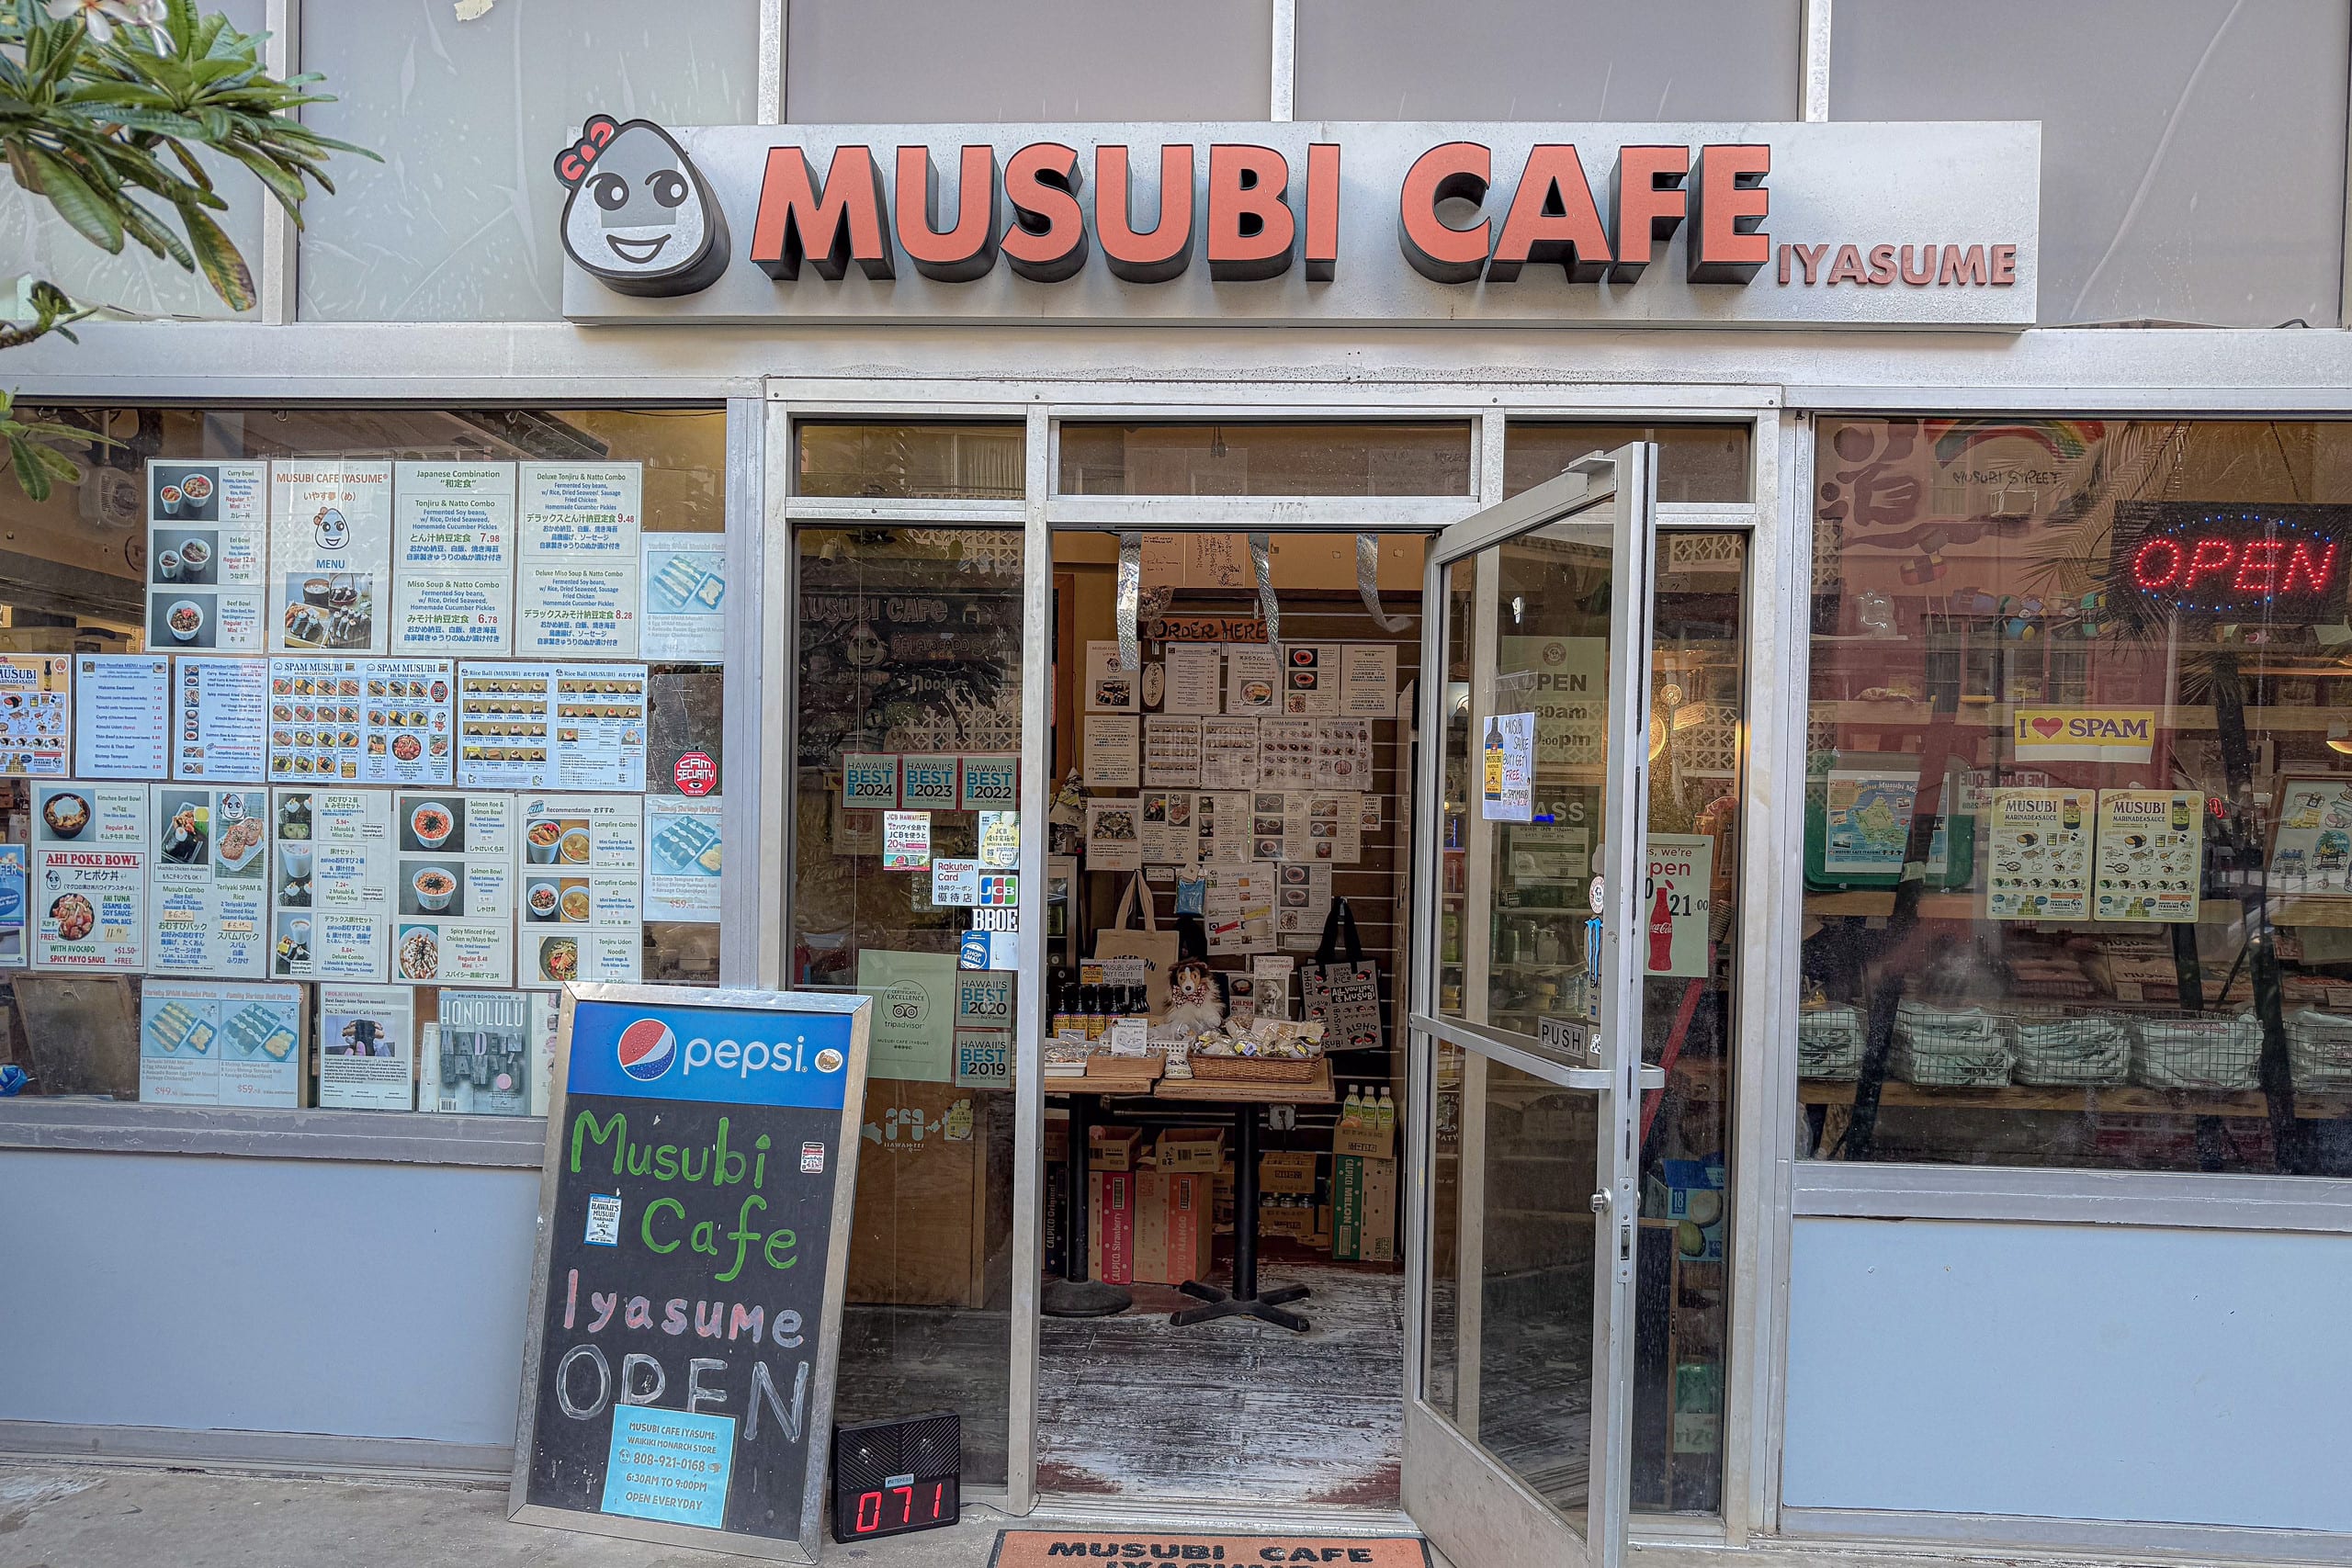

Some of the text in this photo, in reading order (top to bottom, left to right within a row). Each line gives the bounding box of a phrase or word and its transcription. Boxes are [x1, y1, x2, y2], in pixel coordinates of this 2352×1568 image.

[750, 141, 2017, 287] MUSUBI CAFE IYASUME
[277, 473, 339, 483] MUSUBI CAFE
[416, 470, 451, 479] Japanese
[1953, 469, 2063, 486] MUSUBI STREET
[415, 500, 439, 508] Tonjiru
[617, 513, 635, 523] 9.48
[480, 533, 500, 543] 7.98
[316, 559, 345, 569] MENU
[2133, 538, 2336, 592] OPEN
[478, 615, 498, 624] 6.78
[615, 610, 633, 620] 8.28
[1156, 619, 1268, 641] ORDER HERE
[285, 662, 343, 672] SPAM MUSUBI
[377, 663, 435, 672] SPAM MUSUBI
[2019, 716, 2148, 739] I SPAM
[680, 759, 711, 769] CAM
[847, 762, 894, 771] HAWAII'S
[907, 762, 954, 771] HAWAII'S
[967, 763, 1012, 772] HAWAII'S
[676, 769, 715, 782] SECURITY
[847, 770, 894, 784] BEST
[906, 771, 954, 784] BEST
[967, 773, 1012, 785] BEST
[1505, 770, 1520, 781] FREE
[855, 784, 894, 796] 2024
[914, 784, 953, 796] 2023
[974, 786, 1012, 798] 2022
[1878, 782, 1905, 790] Musubi
[1534, 801, 1585, 822] ASS
[2005, 800, 2057, 812] MUSUBI
[2113, 801, 2166, 814] MUSUBI
[888, 840, 906, 849] 20%
[1661, 847, 1692, 857] we're
[46, 852, 140, 866] AHI POKE BOWL
[937, 862, 974, 872] Rakuten
[1646, 861, 1690, 878] pen
[937, 874, 959, 882] Card
[980, 877, 1016, 904] JCB
[961, 980, 1008, 988] HAWAII'S
[961, 987, 1008, 1001] BEST
[440, 999, 524, 1027] HONOLULU
[968, 1001, 1007, 1015] 2020
[885, 1021, 922, 1030] tripadvisor
[1541, 1021, 1583, 1054] PUSH
[961, 1041, 1006, 1049] HAWAII'S
[683, 1035, 804, 1078] pepsi
[960, 1049, 1006, 1062] BEST
[968, 1063, 1006, 1076] 2019
[571, 1109, 771, 1189] Musubi
[591, 1203, 619, 1213] HAWAII'S
[1343, 1187, 1352, 1224] MELON
[641, 1194, 797, 1281] Cafe
[1112, 1213, 1124, 1281] CALPICO Strawberry
[562, 1269, 804, 1348] Iyasume
[556, 1344, 809, 1443] OPEN
[628, 1422, 717, 1440] MUSUBI CAFE IYASUME
[627, 1436, 717, 1454] WAIKIKI MONARCH STORE
[633, 1451, 706, 1472] 808-921-0168
[626, 1472, 707, 1493] 6:30AM TO 9:00PM
[625, 1492, 703, 1511] OPEN EVERYDAY
[856, 1483, 943, 1533] 071
[1048, 1541, 1374, 1563] MUSUBI CAFE
